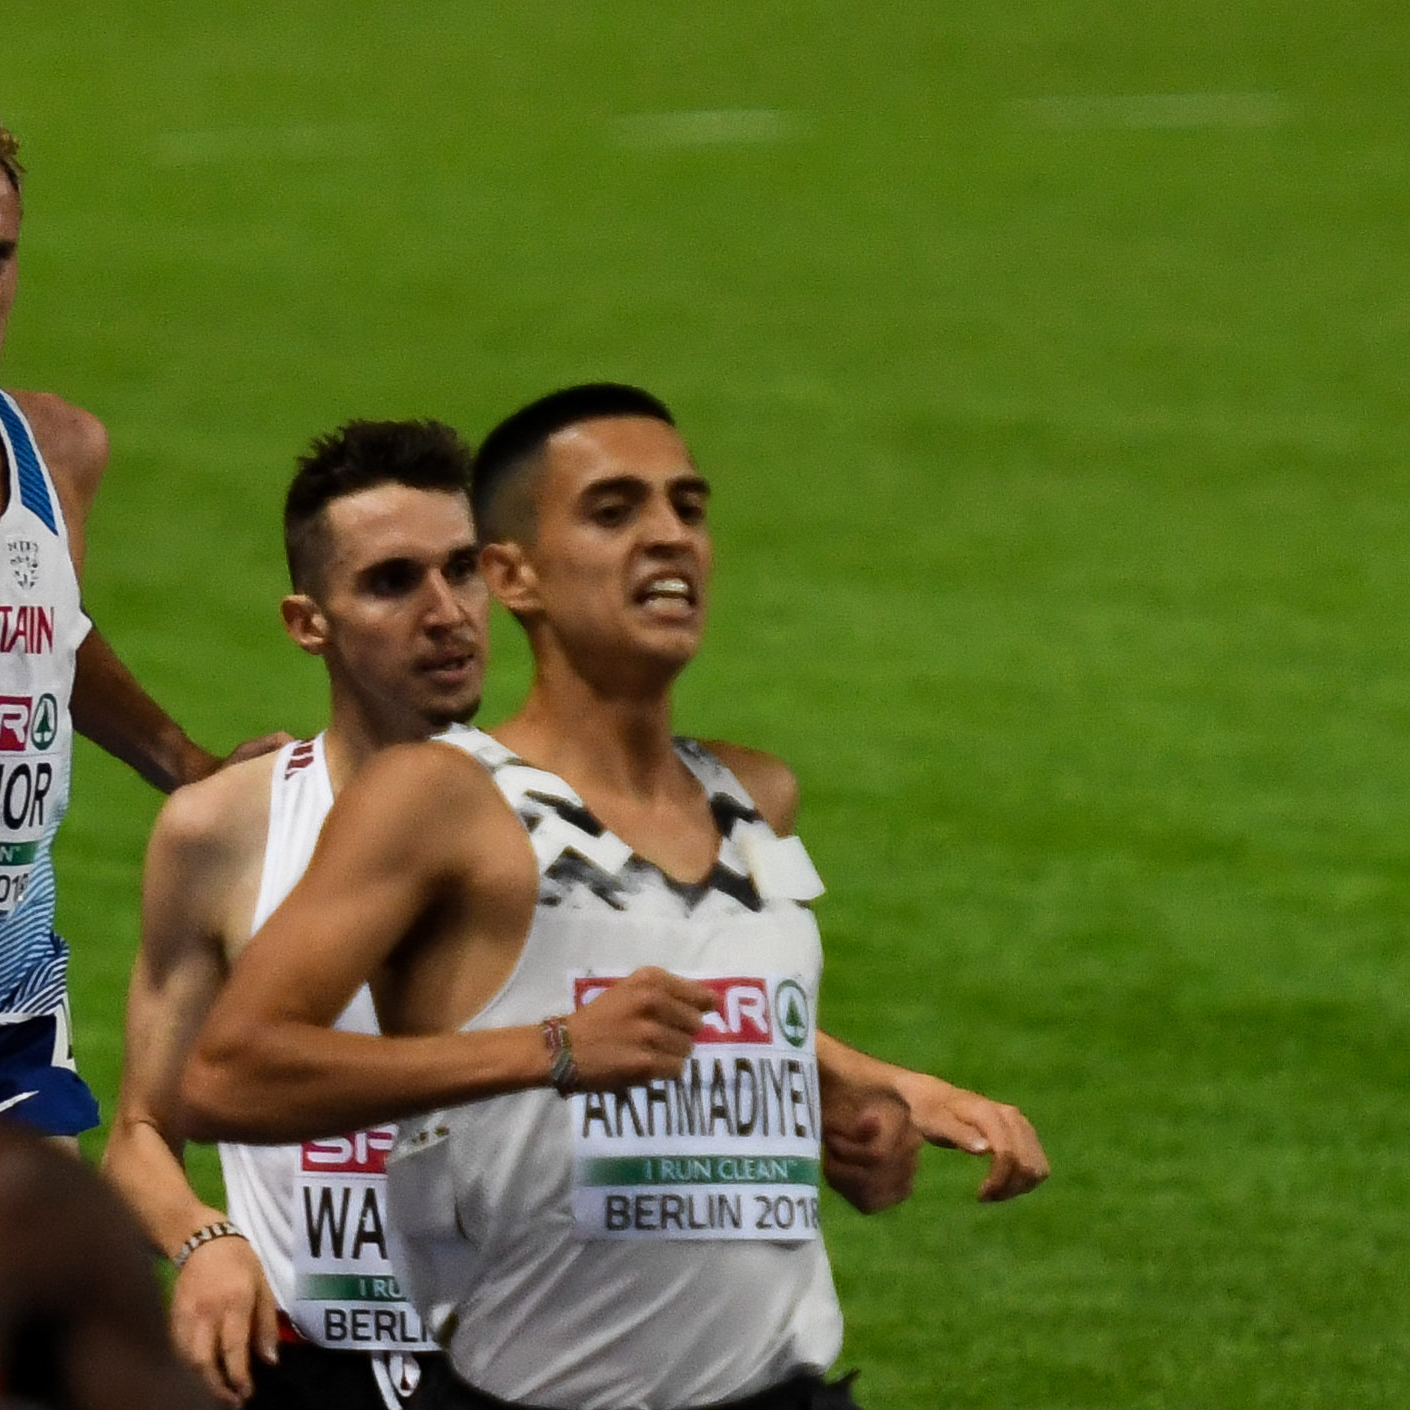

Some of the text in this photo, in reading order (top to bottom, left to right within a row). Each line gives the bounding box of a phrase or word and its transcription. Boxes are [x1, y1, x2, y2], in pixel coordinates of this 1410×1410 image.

[645, 1159, 788, 1179] I RUN CLEAN
[605, 1194, 743, 1231] BERLIN
